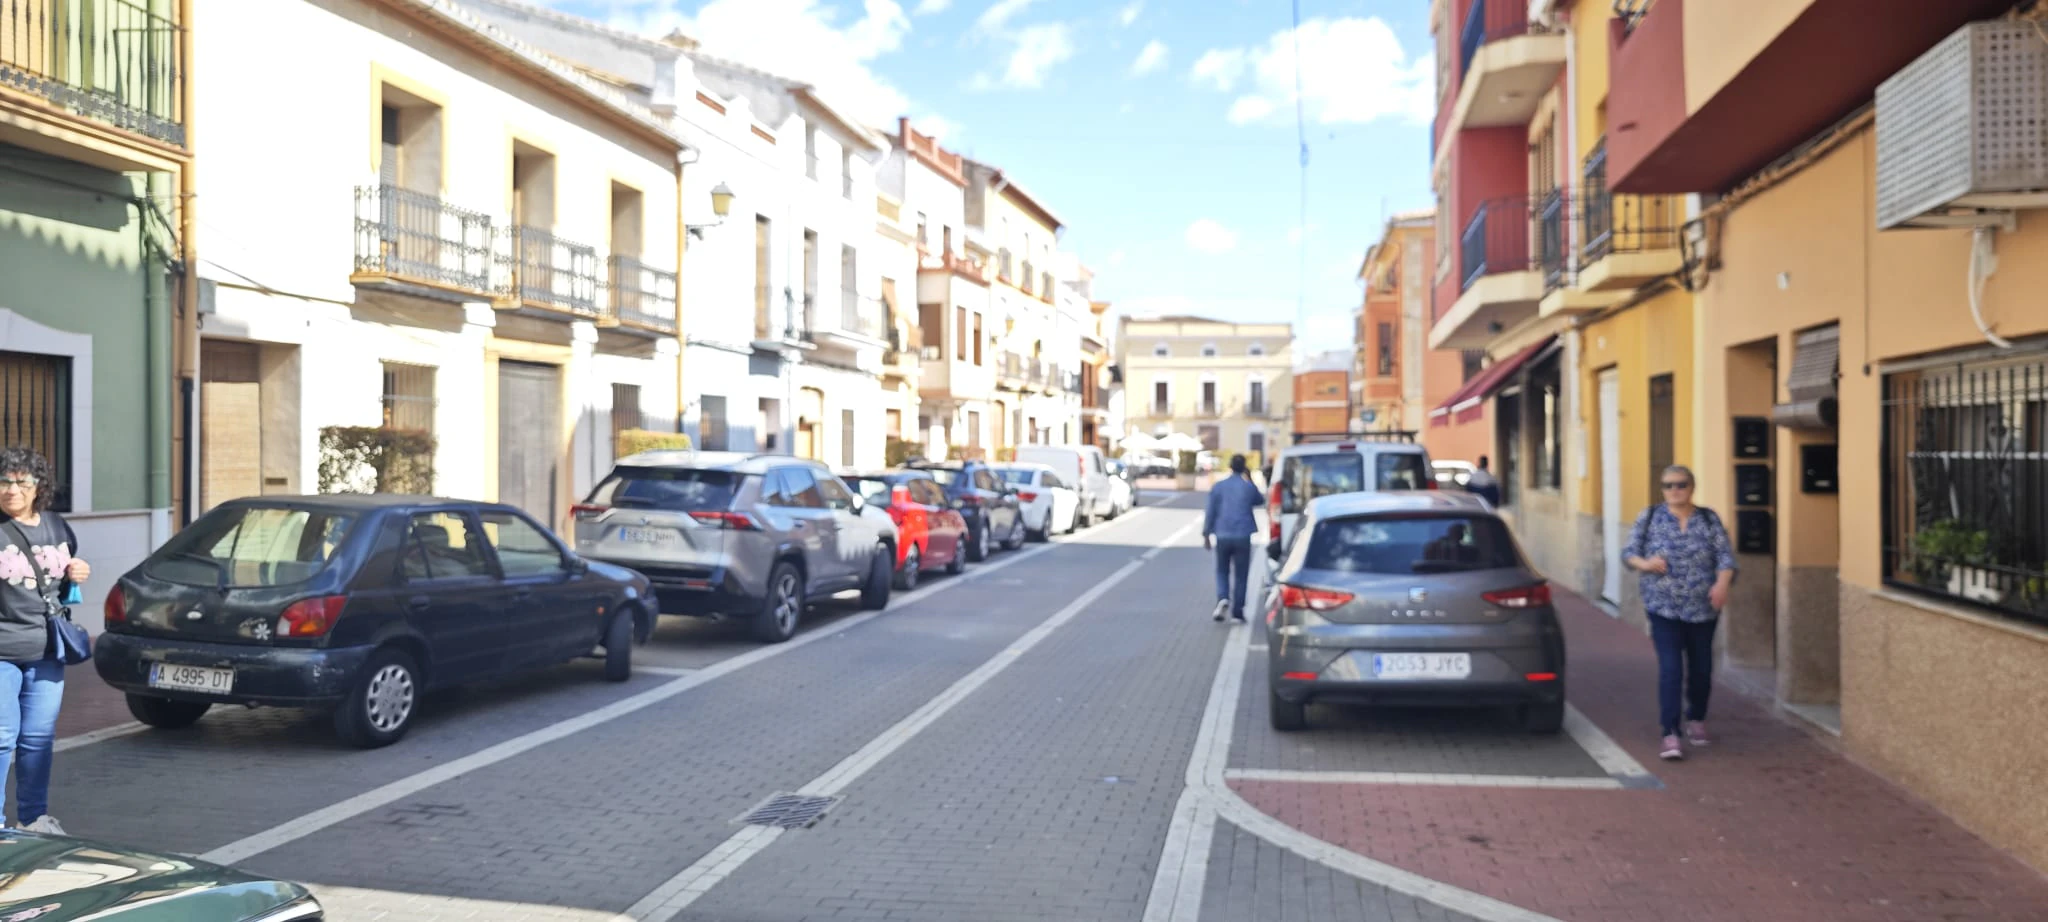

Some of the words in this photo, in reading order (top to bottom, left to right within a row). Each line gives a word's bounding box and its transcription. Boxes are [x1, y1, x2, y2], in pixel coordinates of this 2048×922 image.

[158, 665, 165, 681] A
[172, 666, 206, 686] 4995
[212, 670, 231, 689] DT
